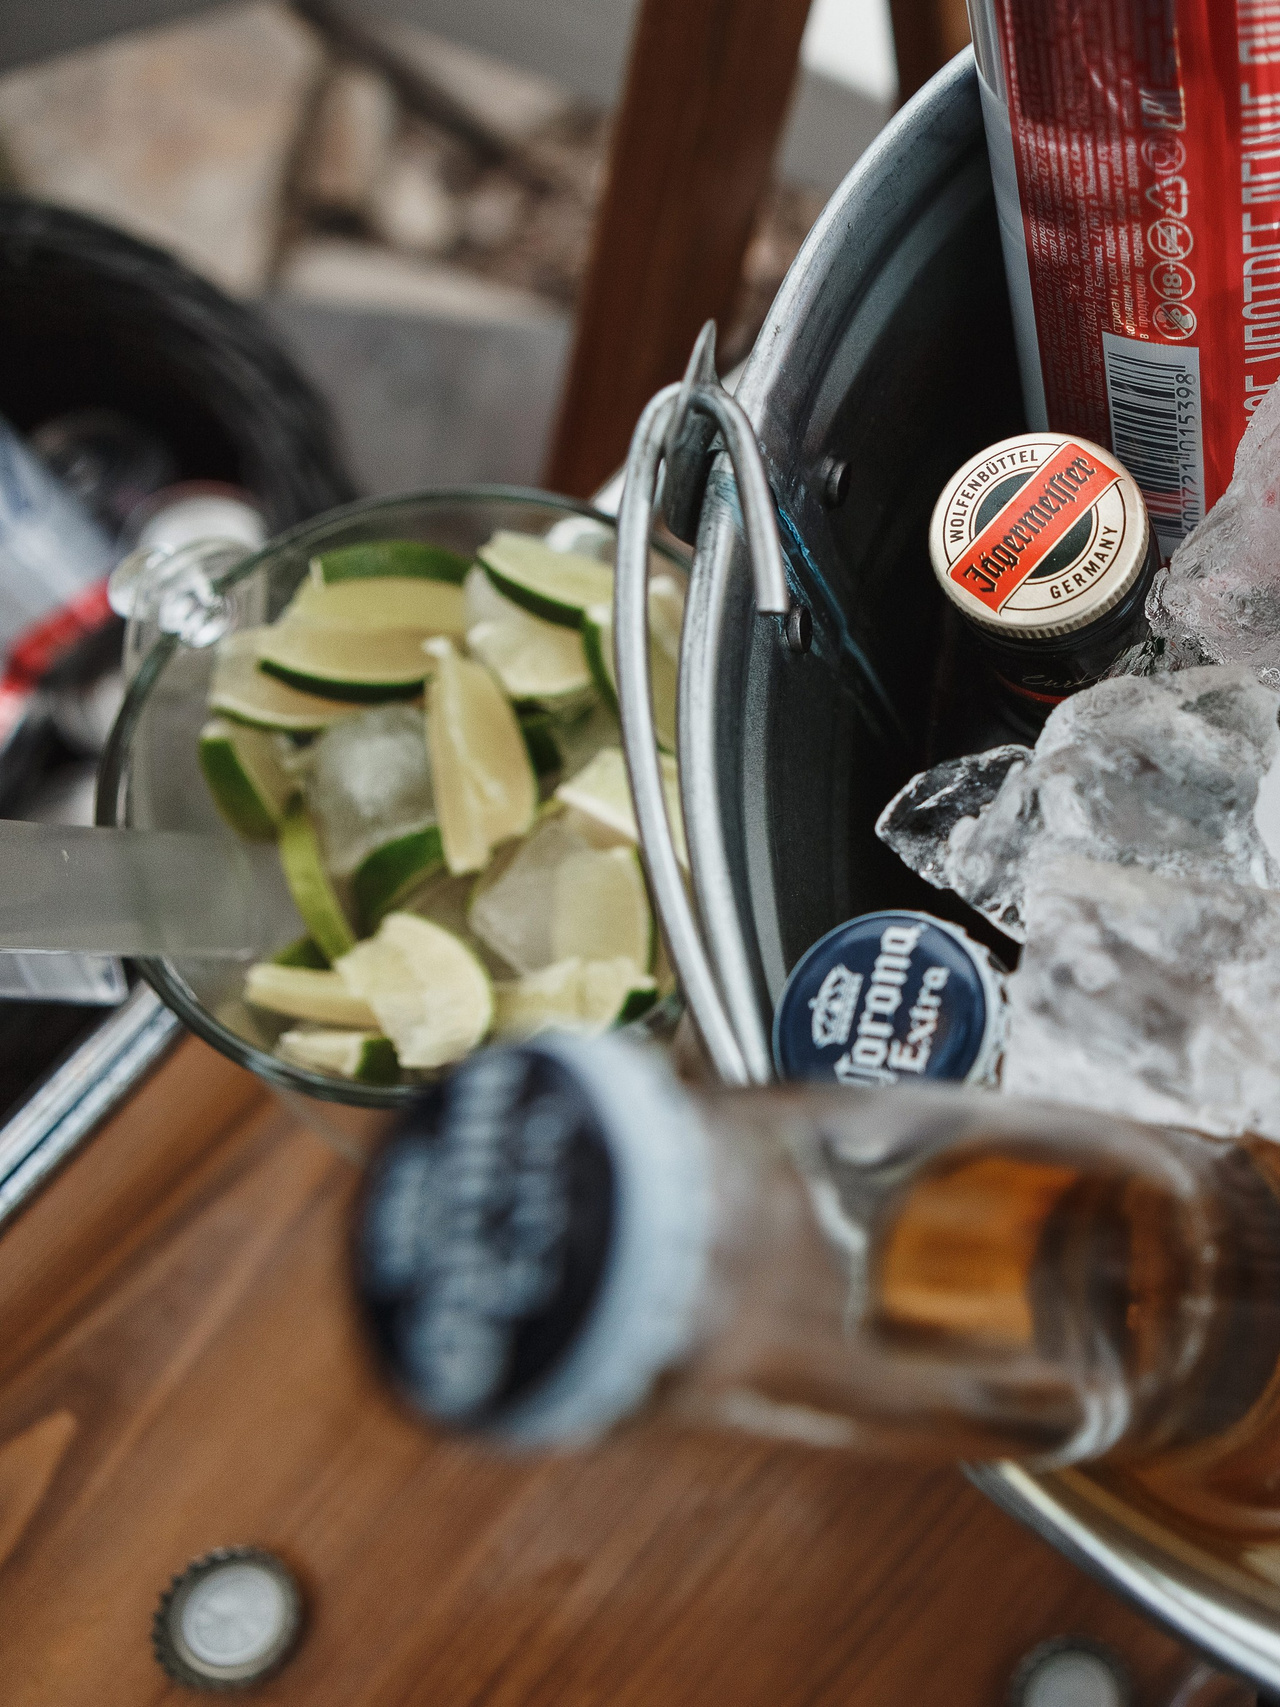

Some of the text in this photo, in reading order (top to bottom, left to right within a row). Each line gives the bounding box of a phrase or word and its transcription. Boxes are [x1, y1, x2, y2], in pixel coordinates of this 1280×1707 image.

[1026, 202, 1043, 286] Экстрактивность
[1077, 199, 1090, 261] Московская
[1103, 210, 1116, 259] годности
[1117, 224, 1131, 283] женщинам,
[1132, 223, 1147, 268] вредных
[1049, 240, 1060, 268] сахар
[1072, 253, 1081, 267] до
[1094, 244, 1106, 289] Багнюка,
[1108, 261, 1120, 285] срок
[1083, 264, 1094, 299] Россия,
[1135, 273, 1151, 328] продукции
[1162, 264, 1183, 296] 18+
[1066, 302, 1075, 324] соль
[1075, 301, 1083, 312] от
[1085, 301, 1098, 338] 141601,
[1100, 318, 1112, 330] ул.
[1109, 298, 1124, 333] строка)
[1122, 285, 1137, 336] кормящим
[1077, 313, 1090, 375] температуре
[1085, 378, 1095, 394] при
[1176, 373, 1197, 452] 015398
[950, 449, 1039, 543] WOLFENBÜTTEL
[962, 456, 1098, 594] Jägermeister
[1049, 525, 1118, 600] GERMANY
[833, 922, 929, 1087] Corona
[887, 966, 950, 1075] Extra
